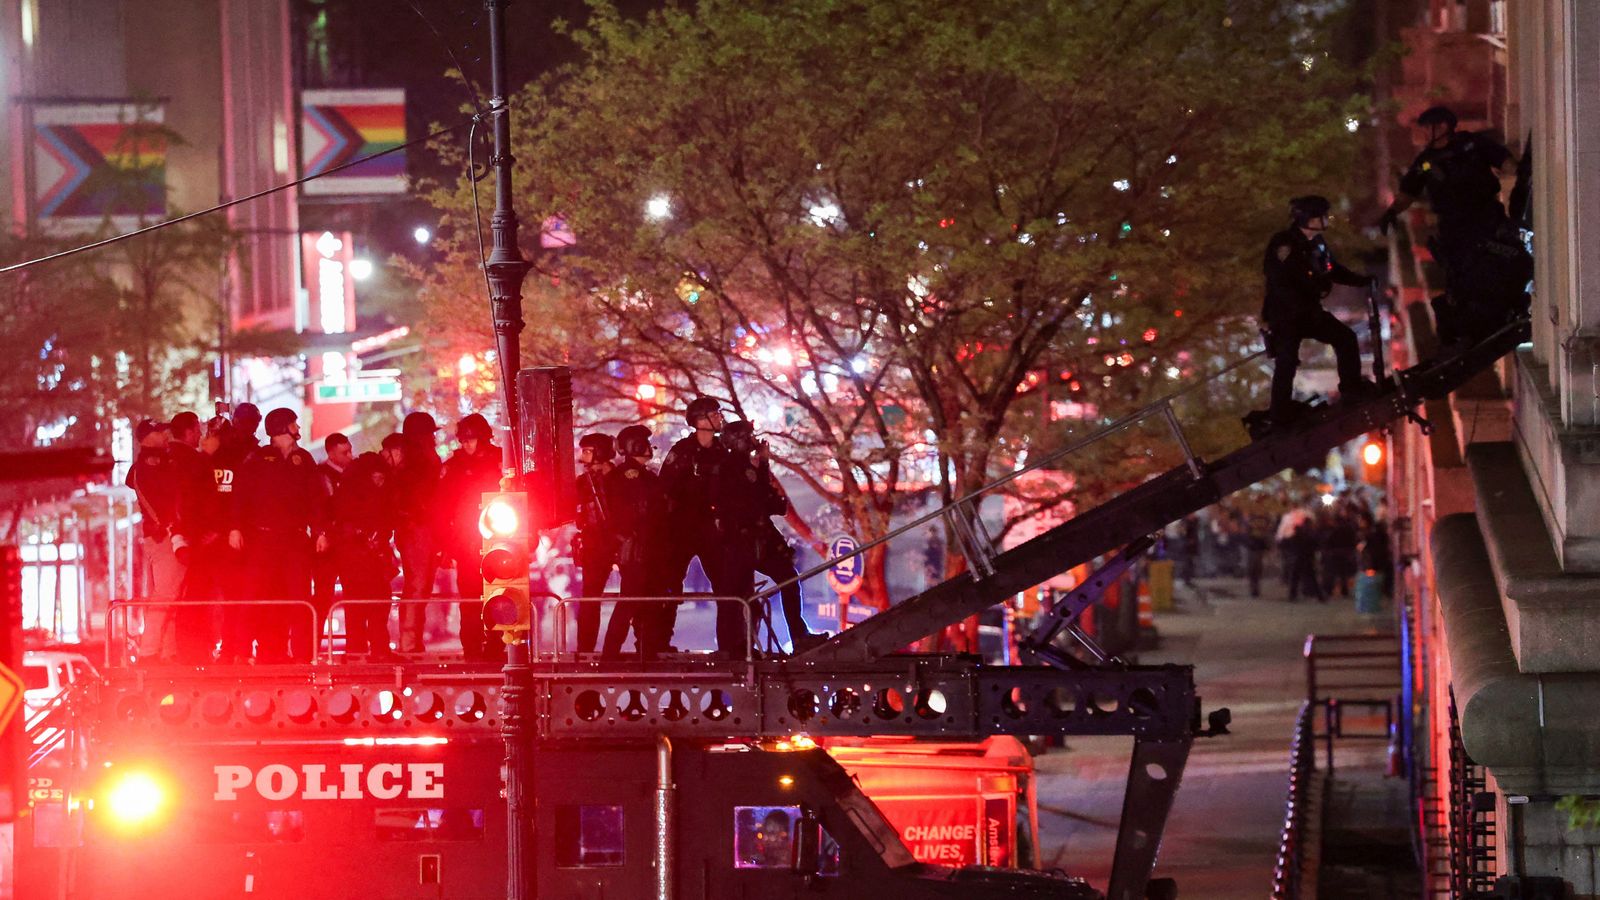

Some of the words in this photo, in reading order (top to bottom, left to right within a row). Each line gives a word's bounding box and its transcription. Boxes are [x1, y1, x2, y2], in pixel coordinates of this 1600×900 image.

[213, 763, 444, 800] POLICE
[904, 825, 974, 841] CHANGE
[914, 844, 965, 862] LIVES,
